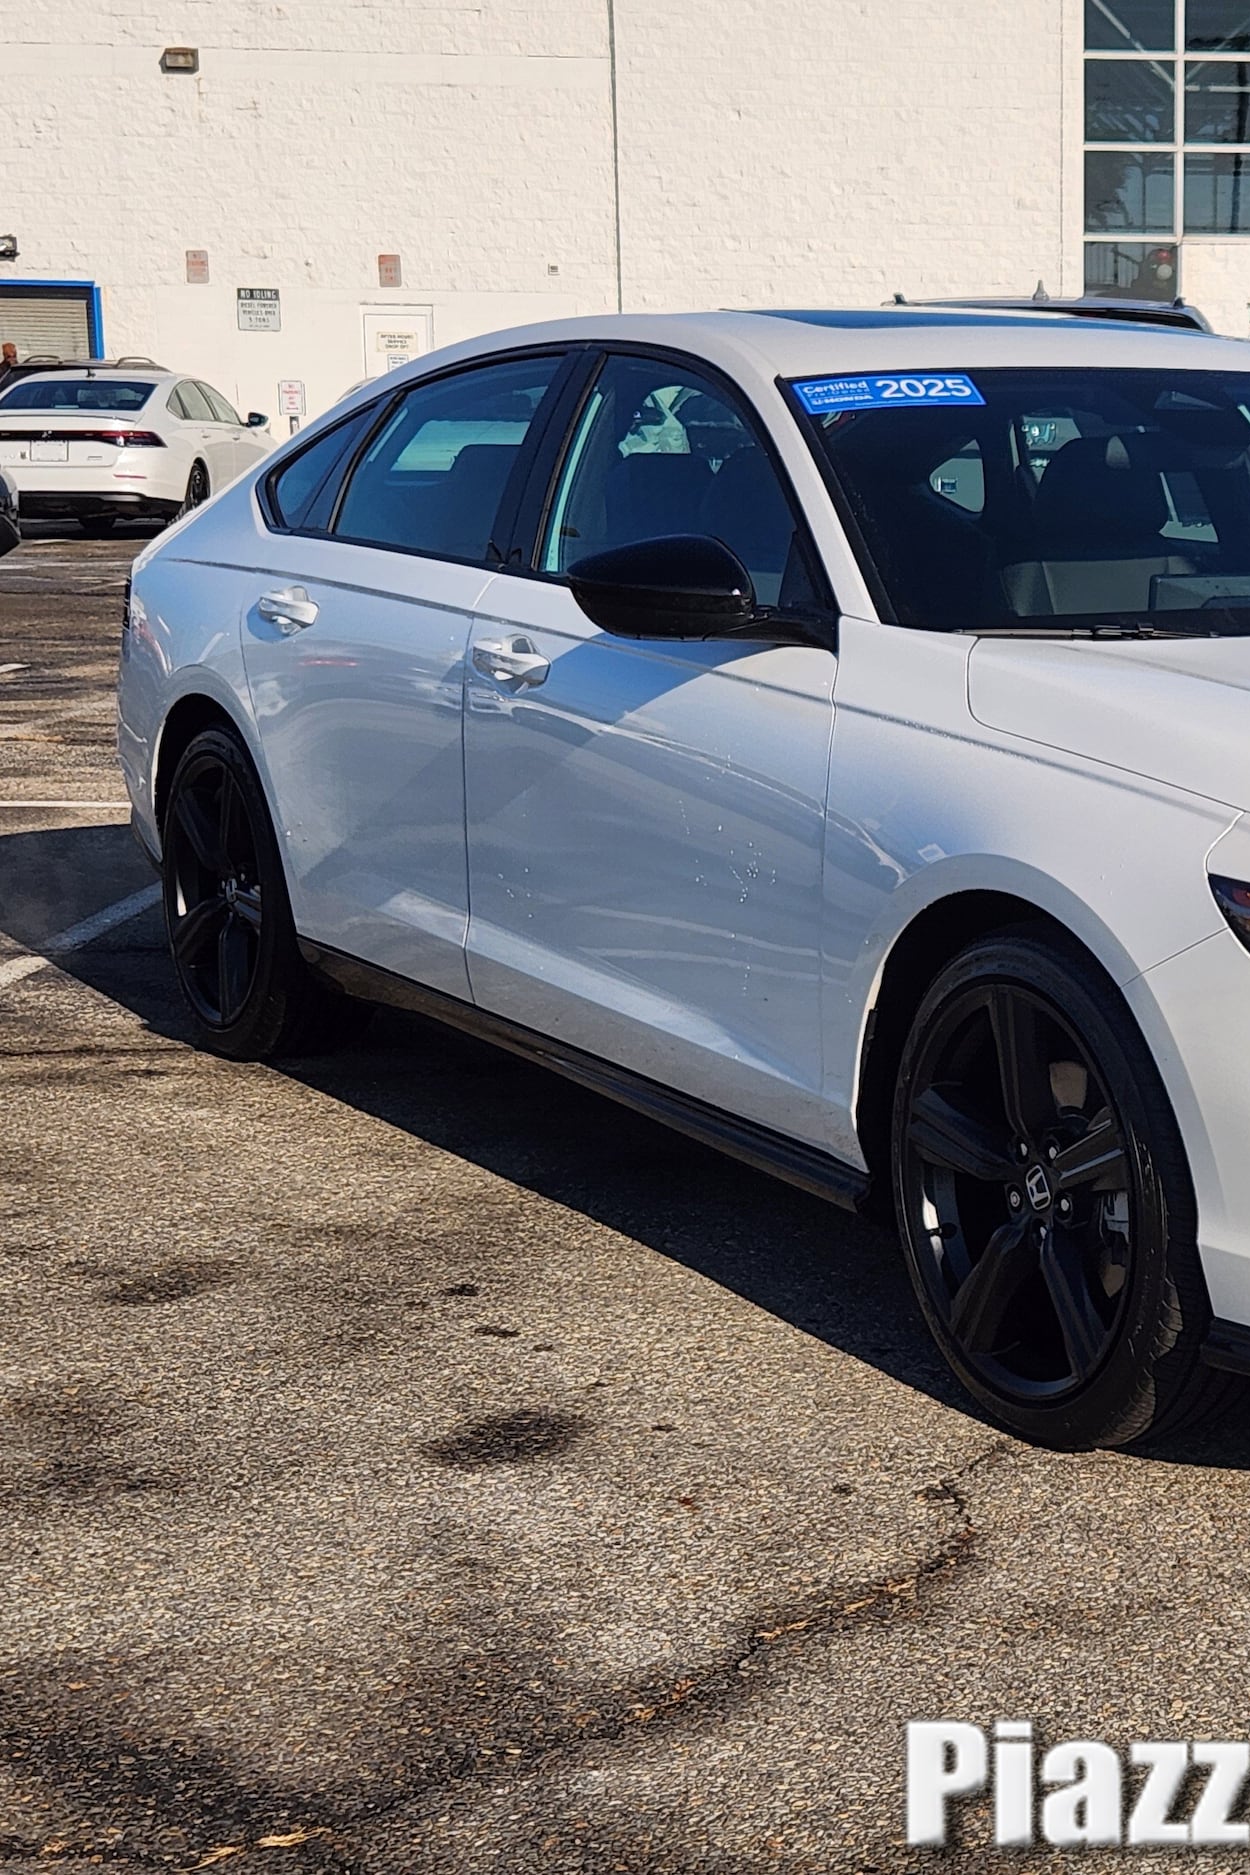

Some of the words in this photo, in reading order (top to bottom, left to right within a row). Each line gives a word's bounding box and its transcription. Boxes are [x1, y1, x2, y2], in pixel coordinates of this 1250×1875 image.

[240, 290, 251, 299] NO
[252, 290, 277, 299] IDLING
[802, 380, 868, 394] Certified
[875, 378, 972, 398] 2025
